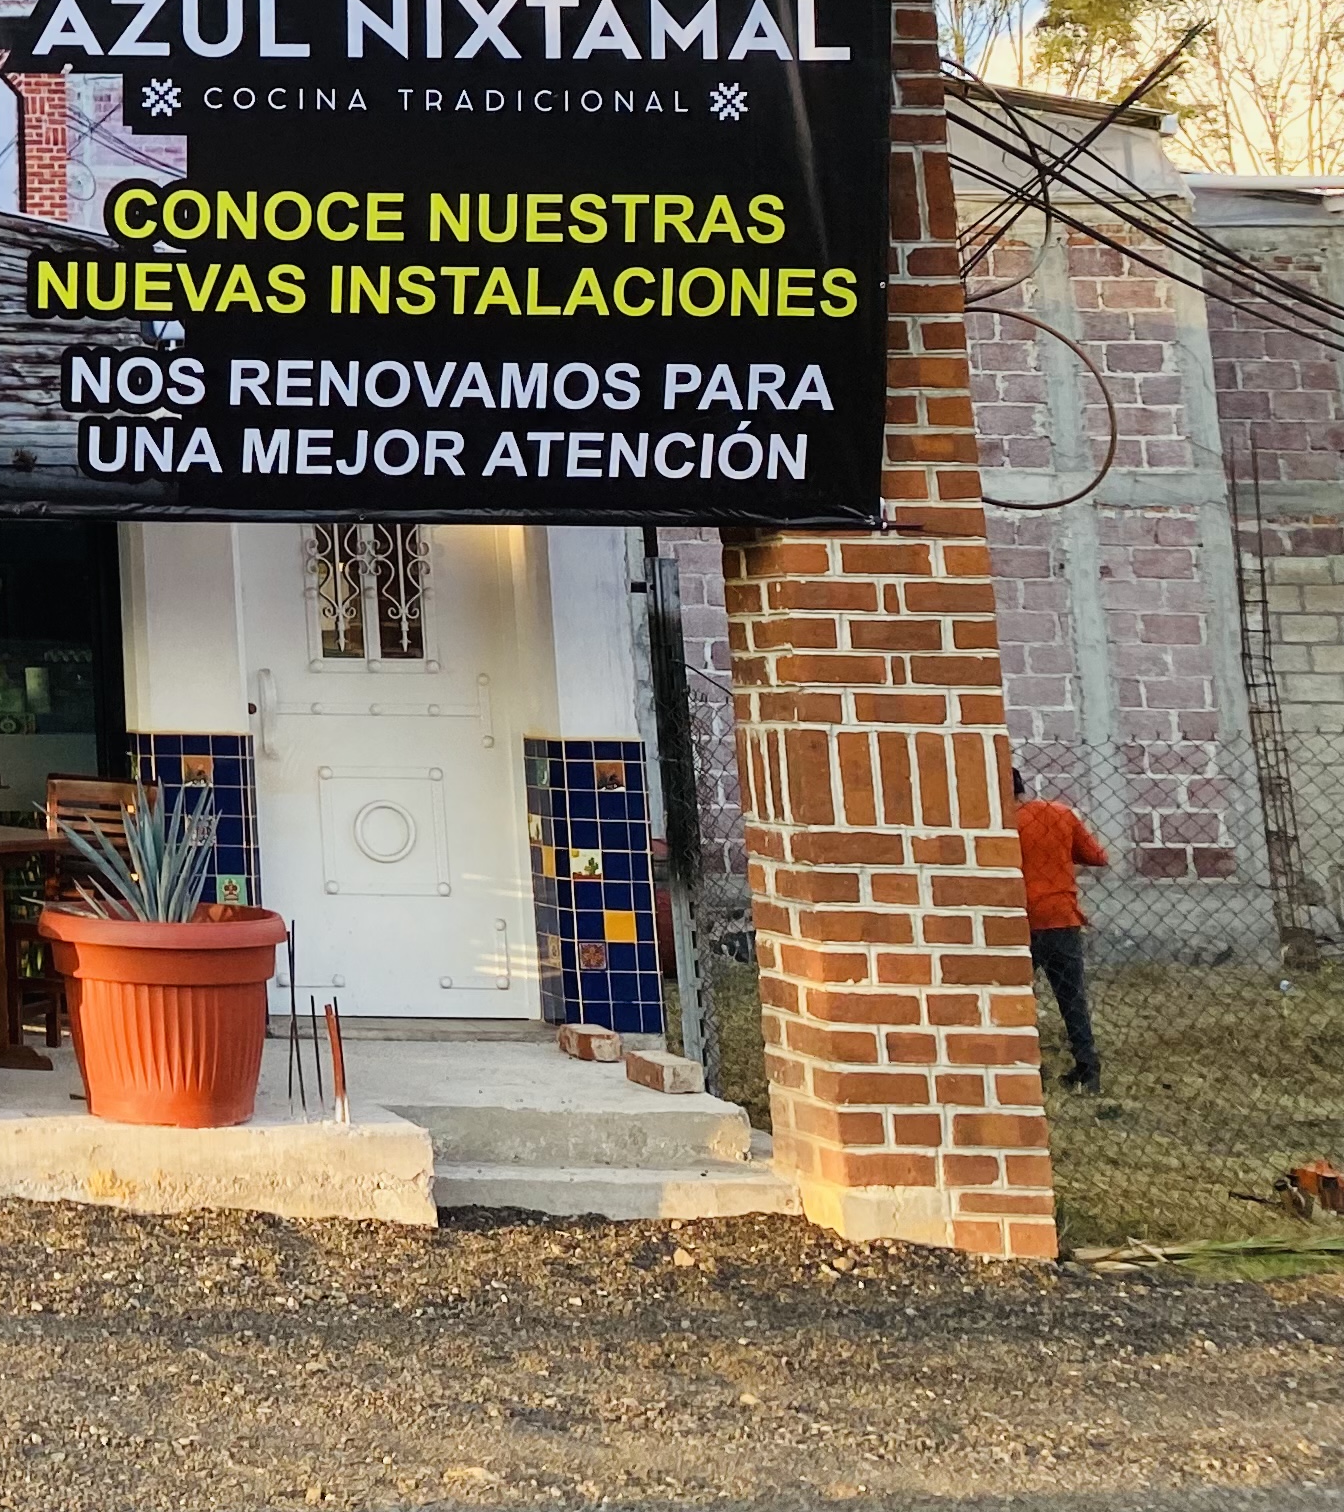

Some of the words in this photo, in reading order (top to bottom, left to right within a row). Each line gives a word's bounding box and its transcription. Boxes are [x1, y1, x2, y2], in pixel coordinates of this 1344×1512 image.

[204, 87, 369, 113] COCINA
[399, 88, 689, 114] TRADICIONAL
[114, 188, 404, 243] CONOCE
[430, 193, 786, 243] NUESTRAS
[37, 262, 306, 314] NUEVAS
[330, 265, 858, 318] INSTALACIONES
[70, 356, 205, 407] NOS
[229, 360, 641, 410] RENOVAMOS
[663, 364, 833, 411] PARA
[86, 427, 223, 474] UNA
[243, 429, 464, 476] MEJOR
[482, 422, 807, 479] ATENCIÓN
